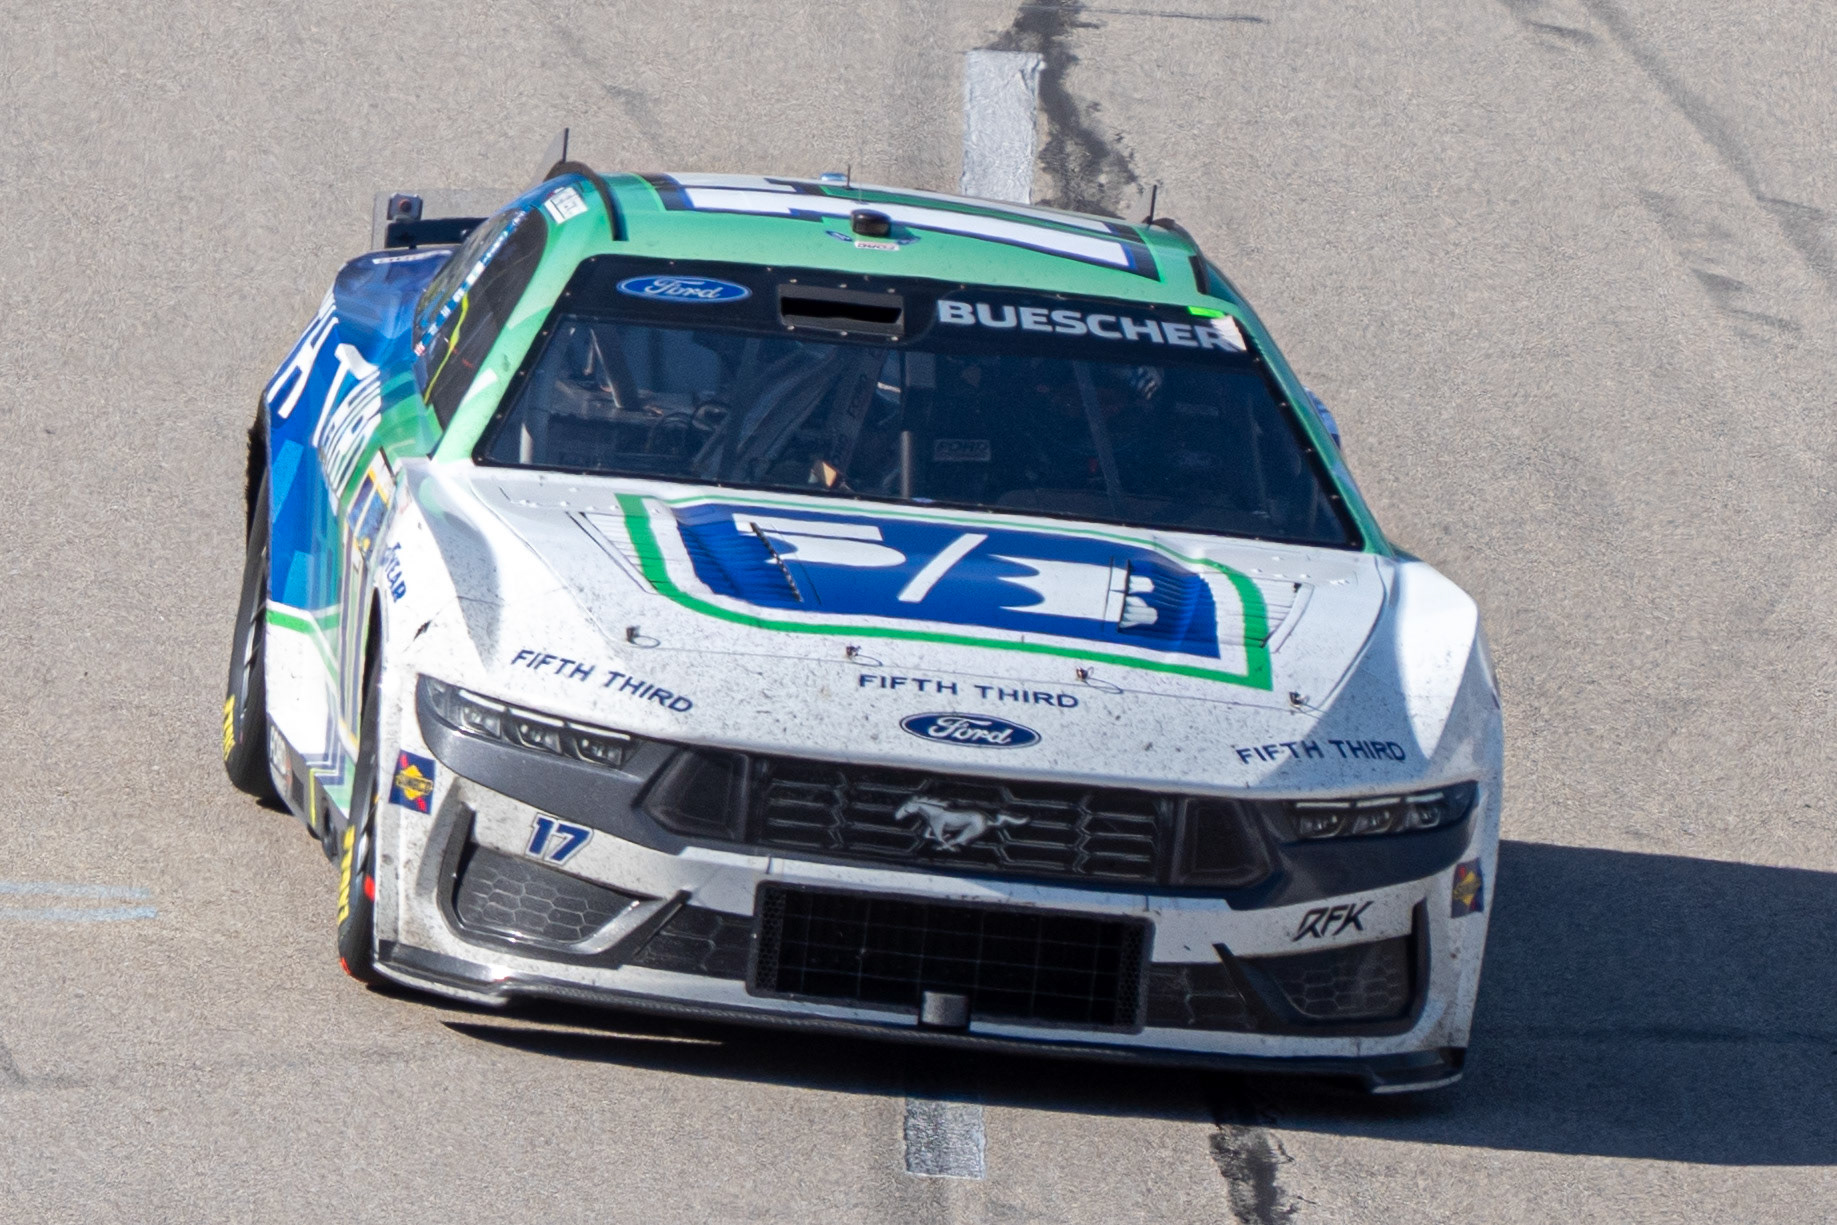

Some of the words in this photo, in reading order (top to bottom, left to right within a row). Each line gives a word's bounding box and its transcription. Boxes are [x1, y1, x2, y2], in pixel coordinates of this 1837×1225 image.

[645, 277, 724, 299] Ford
[937, 299, 1237, 352] BUESCHER
[511, 649, 597, 684] FIFTH
[608, 670, 694, 715] THIRD
[859, 673, 958, 696] FIFTH
[972, 684, 1079, 710] THIRD
[927, 716, 1014, 745] Ford
[1235, 739, 1325, 765] FIFTH
[1328, 739, 1407, 763] THIRD
[526, 814, 591, 865] 17
[1292, 900, 1375, 943] RFK
